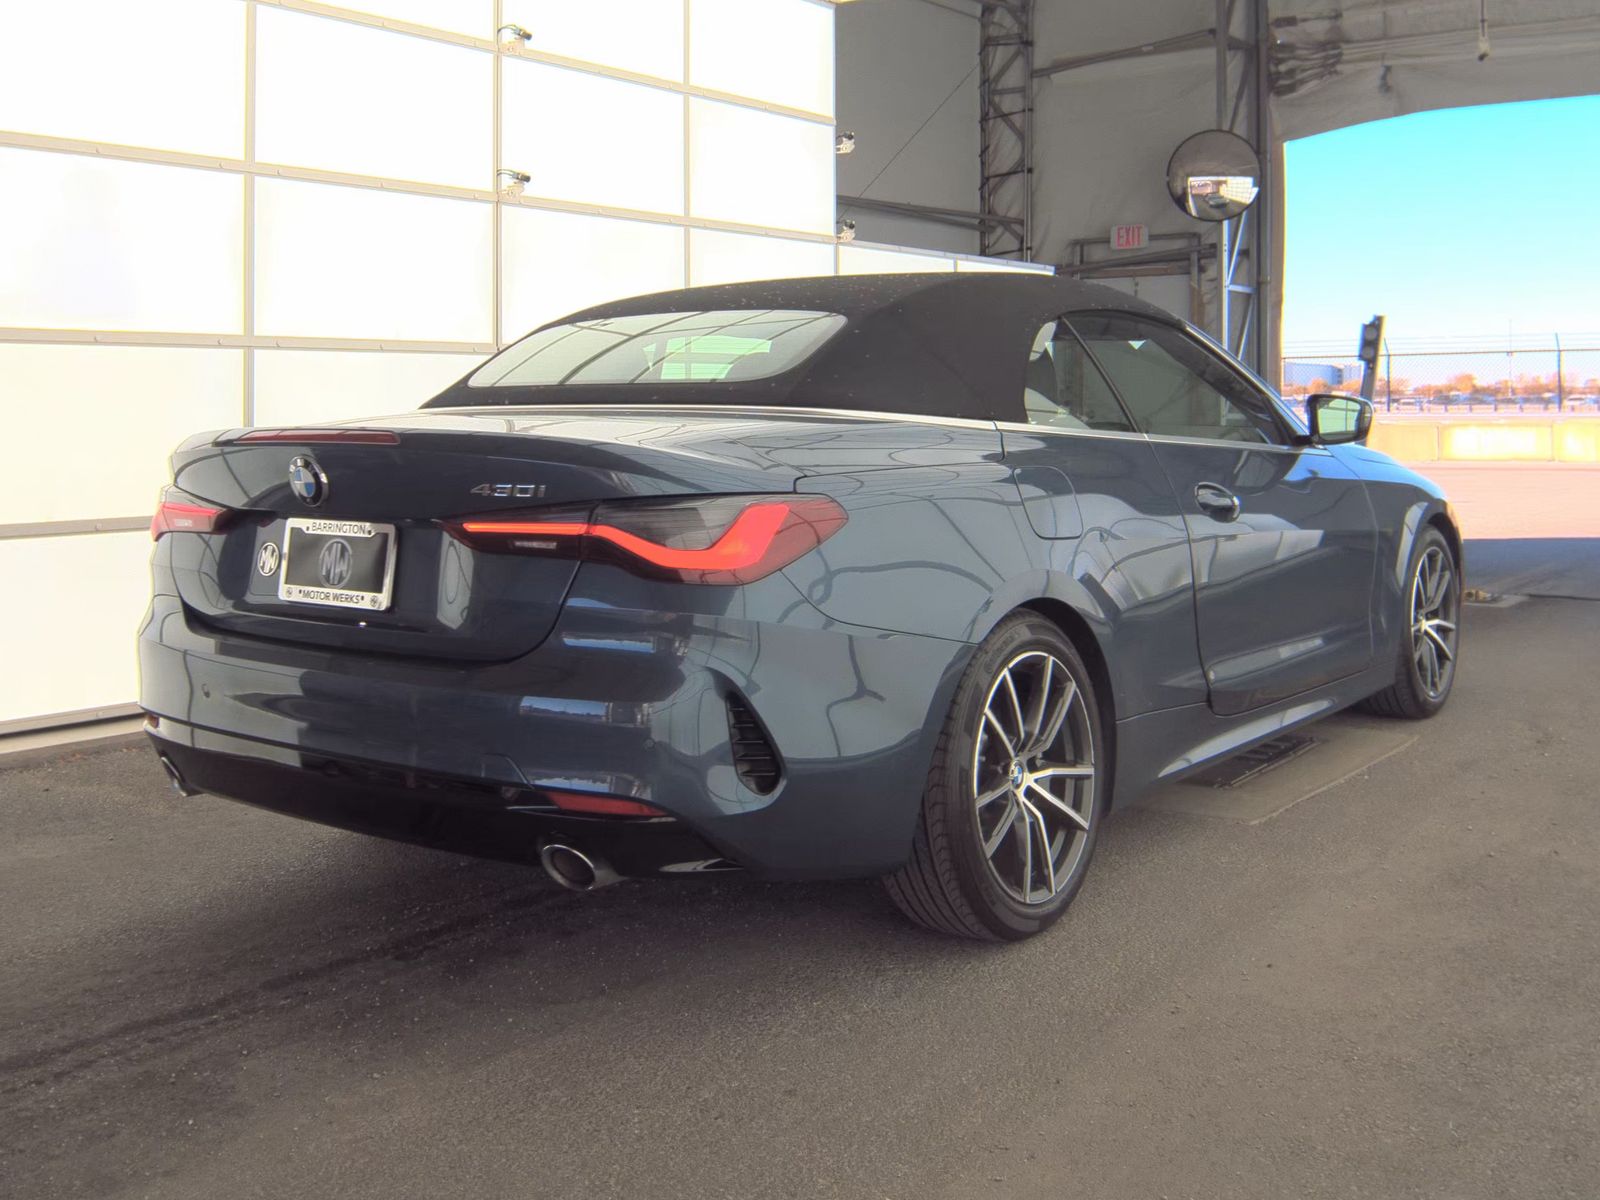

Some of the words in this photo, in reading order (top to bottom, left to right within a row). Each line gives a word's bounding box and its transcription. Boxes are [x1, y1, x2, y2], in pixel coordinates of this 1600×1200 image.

[1116, 225, 1143, 247] EXIT
[470, 483, 546, 497] 430i
[311, 521, 366, 535] BARRINGTON
[302, 589, 330, 601] MOTOR
[332, 592, 361, 604] WERKS
